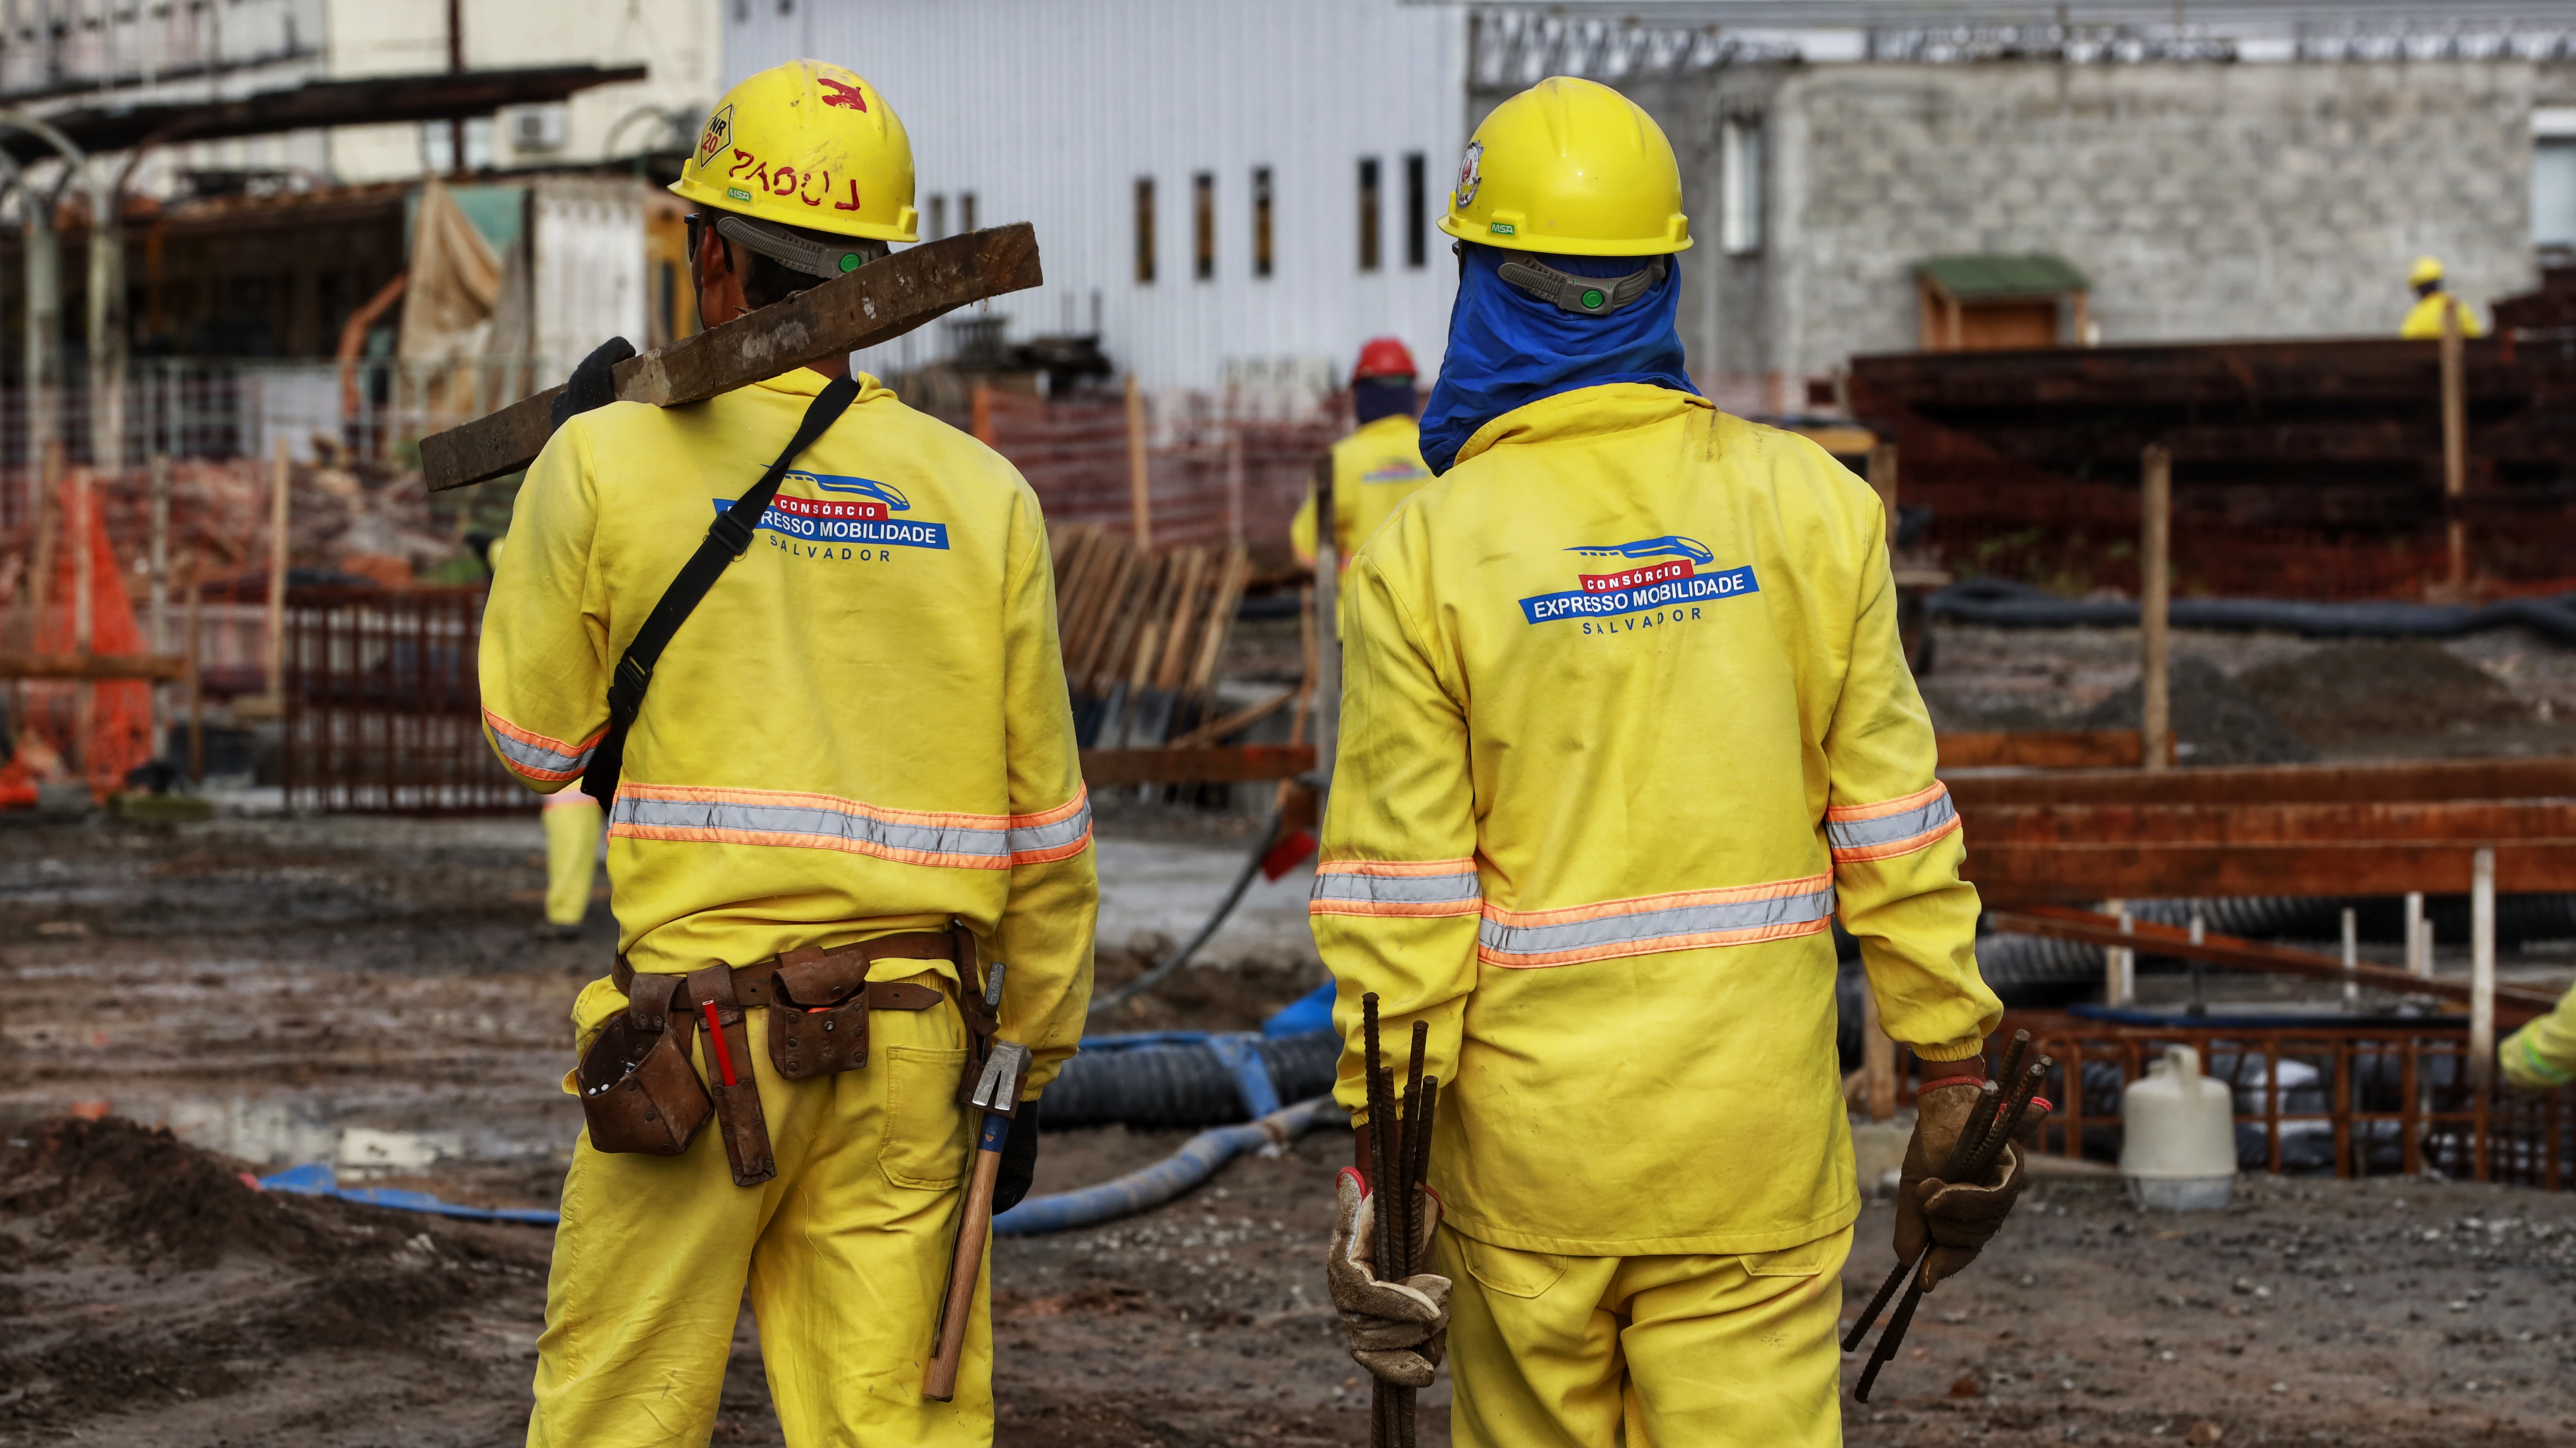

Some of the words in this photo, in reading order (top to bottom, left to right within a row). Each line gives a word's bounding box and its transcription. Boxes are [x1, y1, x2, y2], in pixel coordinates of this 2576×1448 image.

[710, 117, 726, 136] NR
[702, 132, 718, 154] 20
[729, 189, 750, 201] MSA
[1492, 224, 1513, 234] MSA
[780, 499, 875, 517] CONSÓRCIO
[820, 521, 937, 544] MOBILIDADE
[770, 535, 890, 562] SALVADOR
[1587, 565, 1682, 590] CONSÓRCIO
[1534, 595, 1629, 618] EXPRESSO
[1633, 573, 1745, 606] MOBILIDADE
[1583, 608, 1701, 635] SALVADOR
